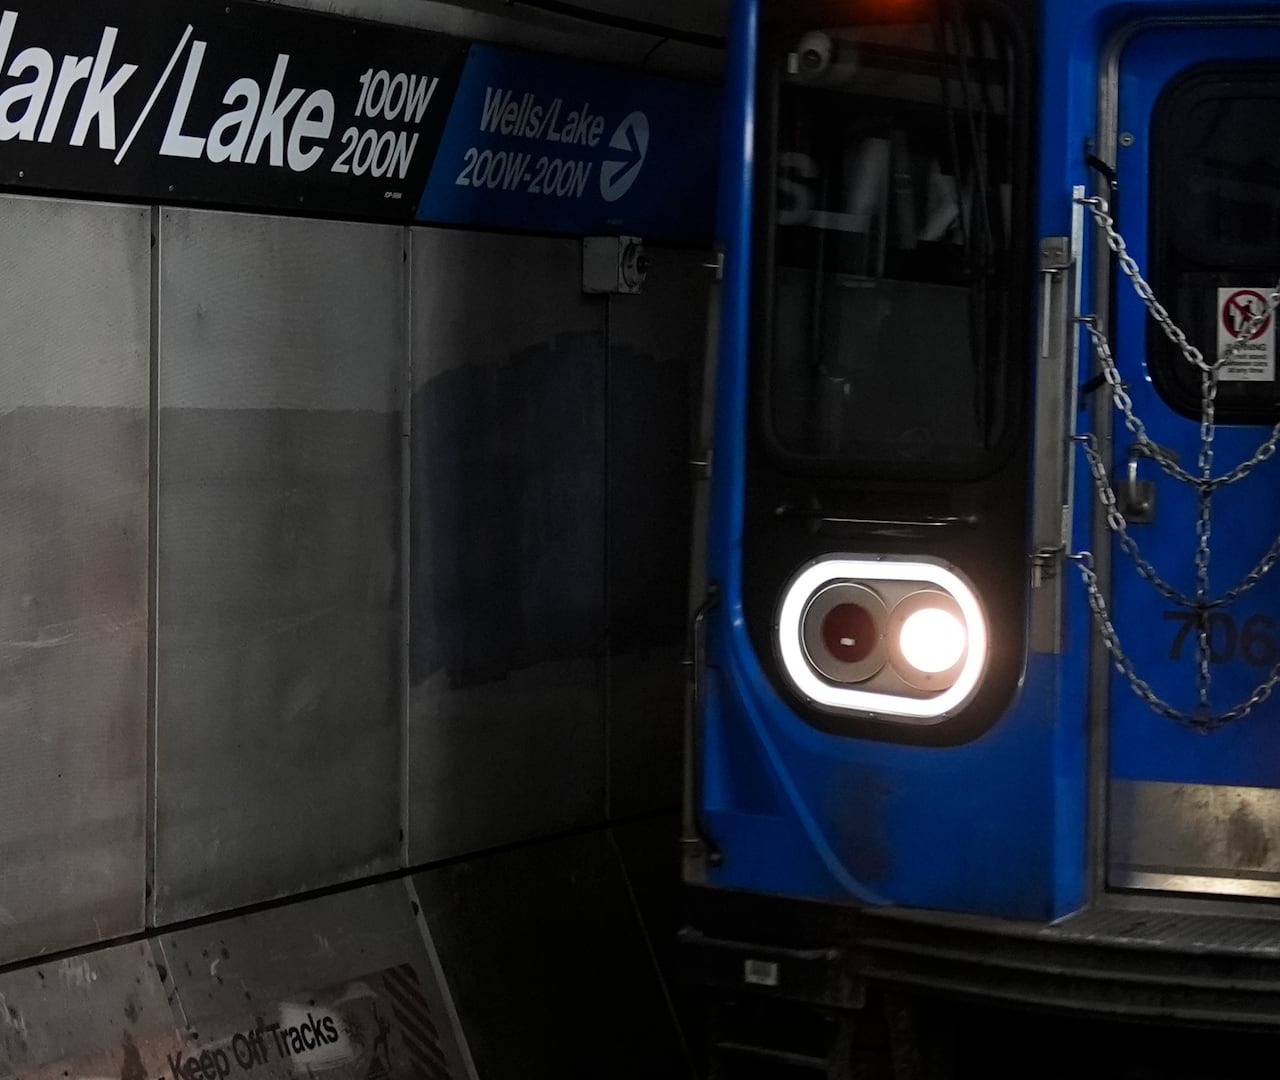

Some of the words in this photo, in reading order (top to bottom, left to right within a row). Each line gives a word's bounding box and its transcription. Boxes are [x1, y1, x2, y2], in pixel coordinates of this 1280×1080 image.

[354, 68, 439, 125] 100W
[480, 86, 605, 147] Wells/Lake
[331, 126, 421, 180] 200N
[455, 146, 593, 199] 200W-200N
[167, 1048, 230, 1080] Keep
[232, 1027, 269, 1071] Off
[264, 1013, 339, 1059] Tracks
